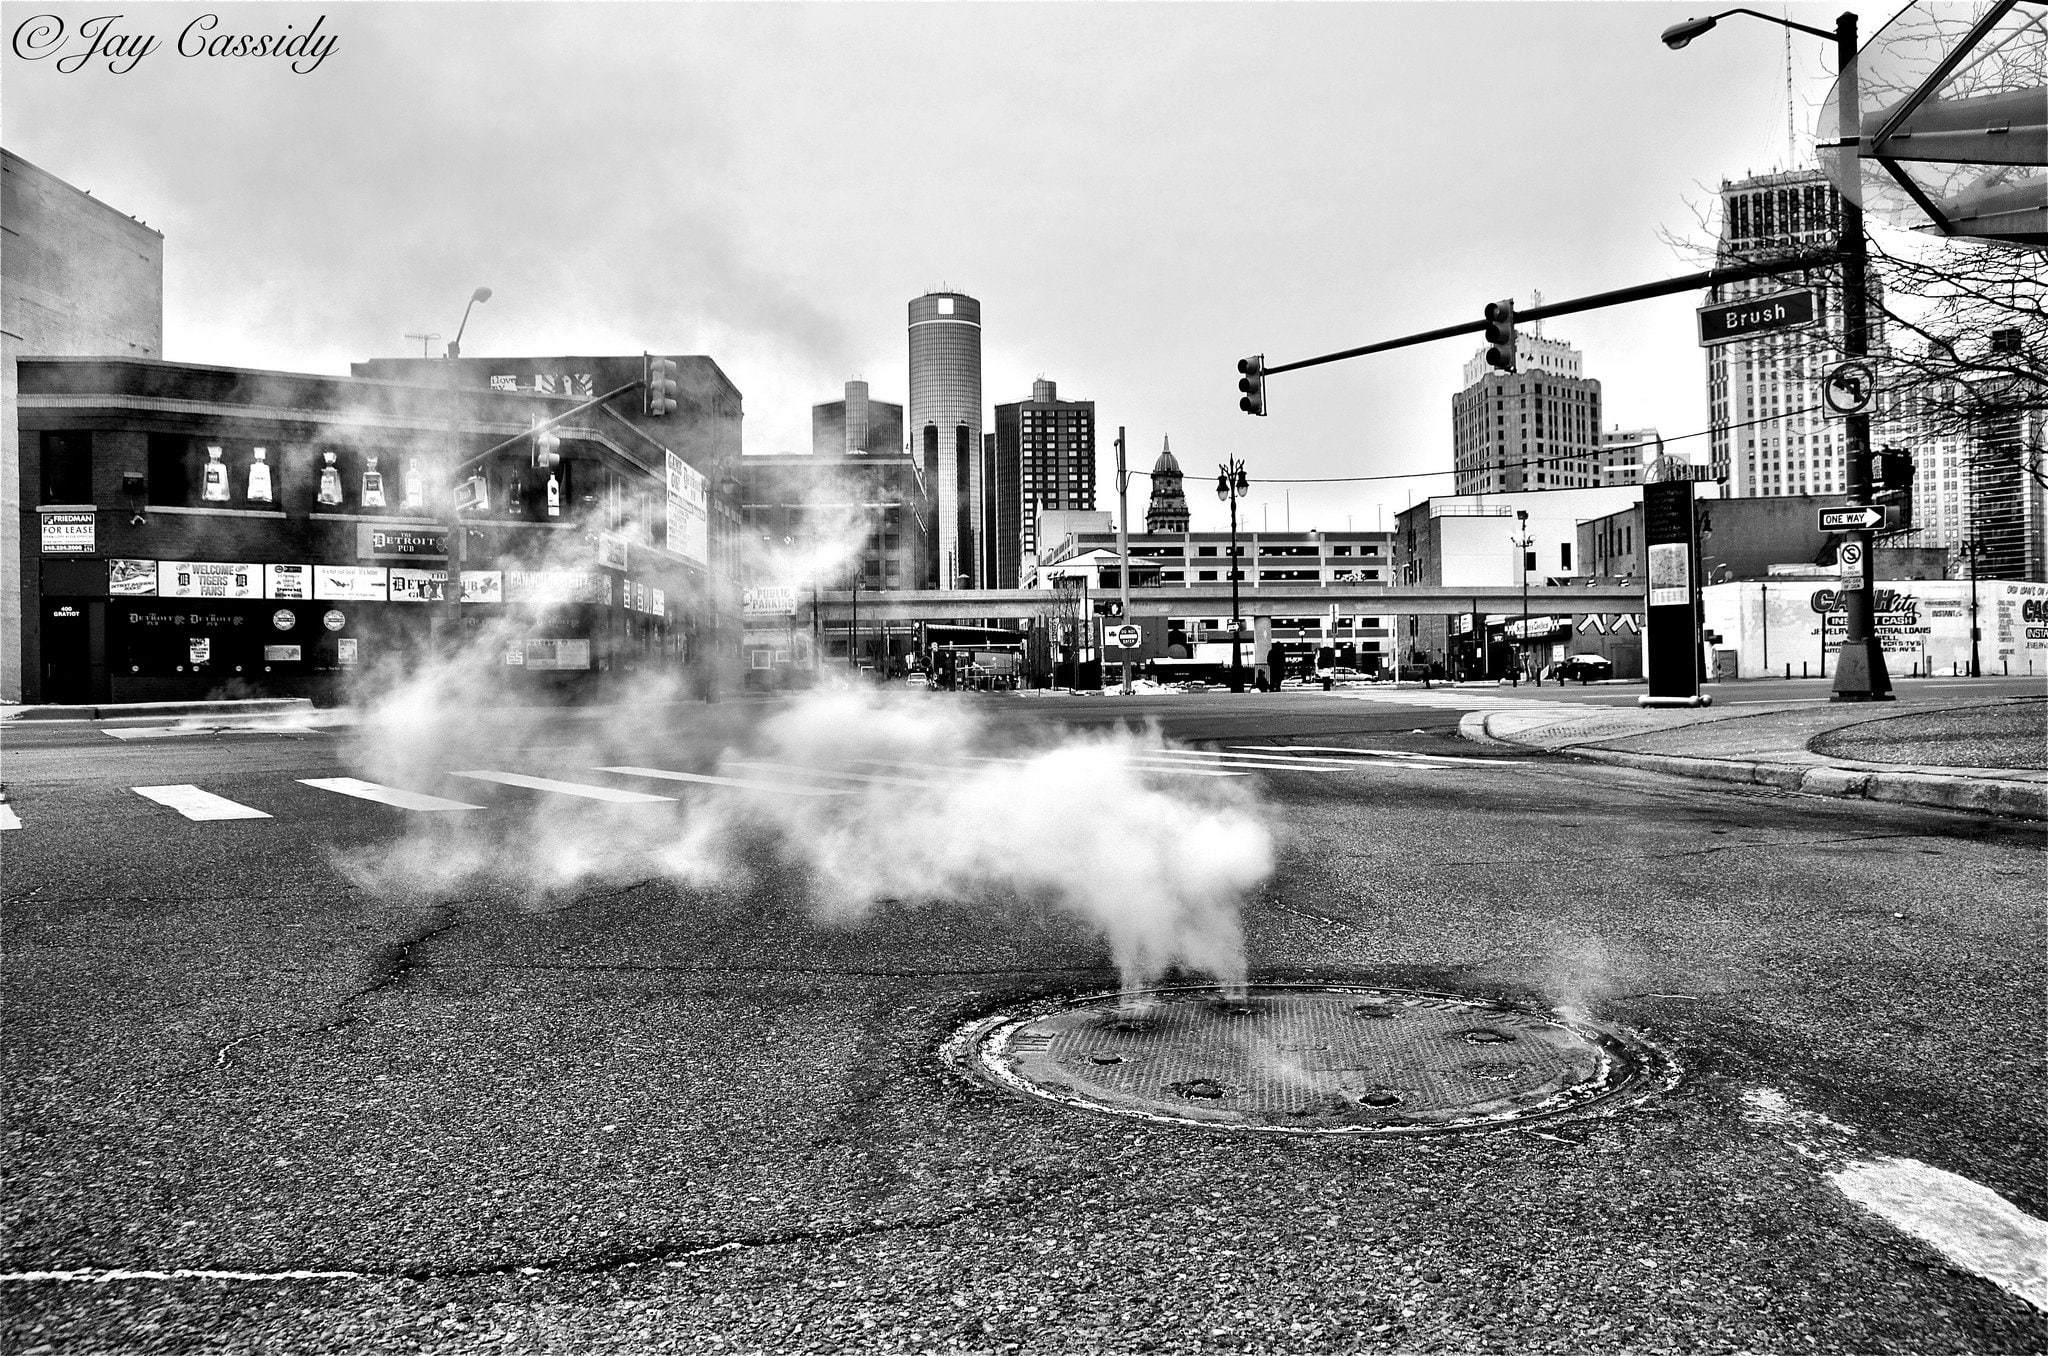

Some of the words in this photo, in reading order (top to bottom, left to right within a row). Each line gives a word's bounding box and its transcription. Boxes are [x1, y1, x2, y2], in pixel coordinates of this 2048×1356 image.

[1726, 303, 1786, 329] Brush
[1825, 514, 1844, 524] ONE
[1847, 513, 1865, 523] WAY
[43, 526, 61, 534] FOR
[66, 526, 93, 534] LEASE
[373, 533, 436, 548] DETROIT
[192, 564, 234, 576] WELCOME
[198, 575, 228, 586] TIGERS
[200, 586, 226, 596] FANS!
[757, 588, 790, 599] PUBLIC
[752, 598, 794, 610] PARKING
[1811, 589, 1894, 614] CAH
[1890, 593, 1922, 618] City
[129, 613, 172, 623] DETROIT
[1882, 616, 1912, 624] CASH
